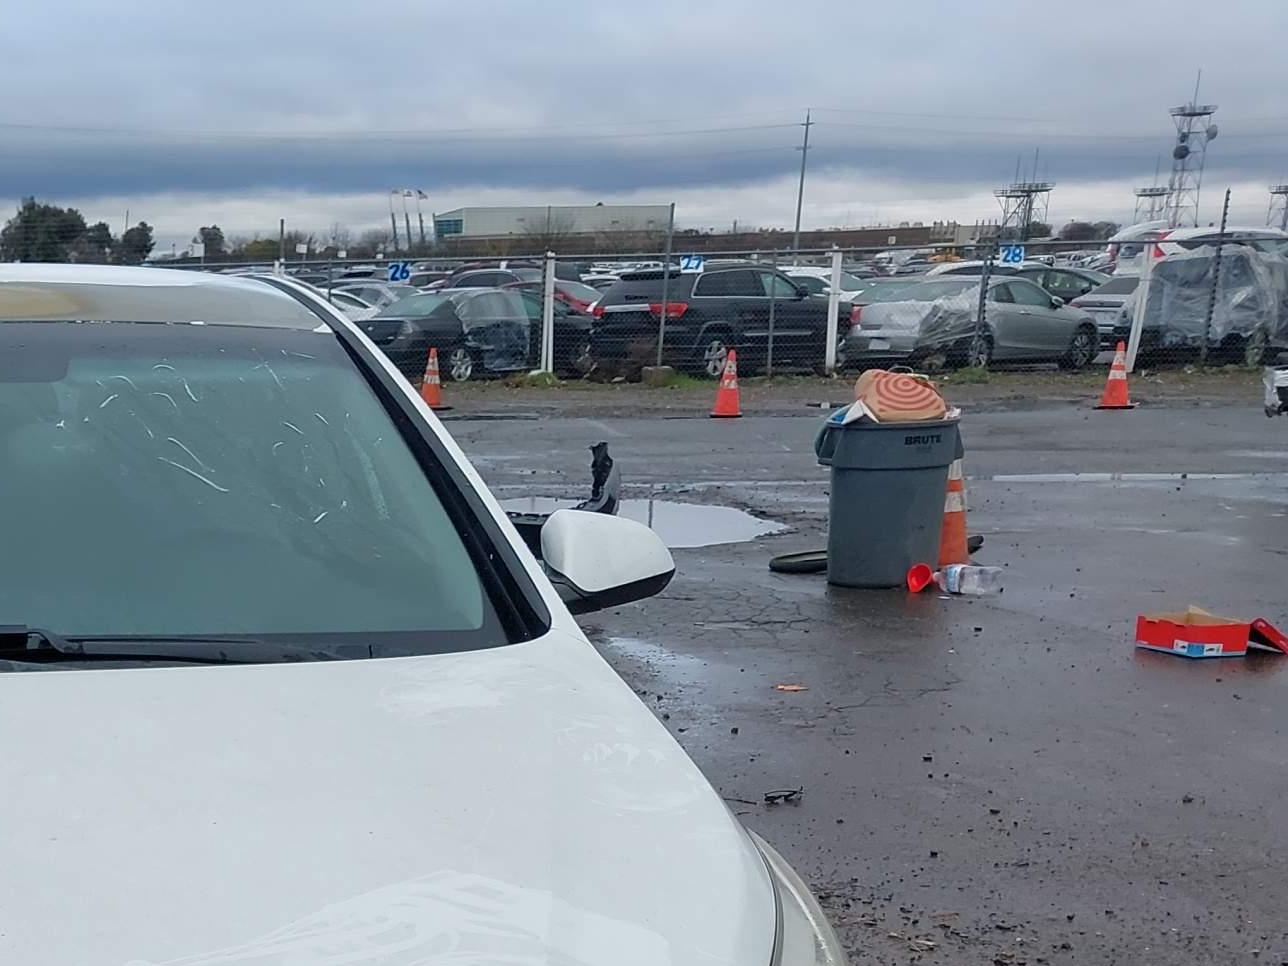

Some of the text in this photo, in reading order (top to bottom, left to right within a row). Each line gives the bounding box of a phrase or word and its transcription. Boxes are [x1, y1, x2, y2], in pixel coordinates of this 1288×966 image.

[681, 255, 703, 271] 27
[1002, 246, 1023, 264] 28
[388, 262, 410, 282] 26
[904, 434, 942, 446] BRUTE
